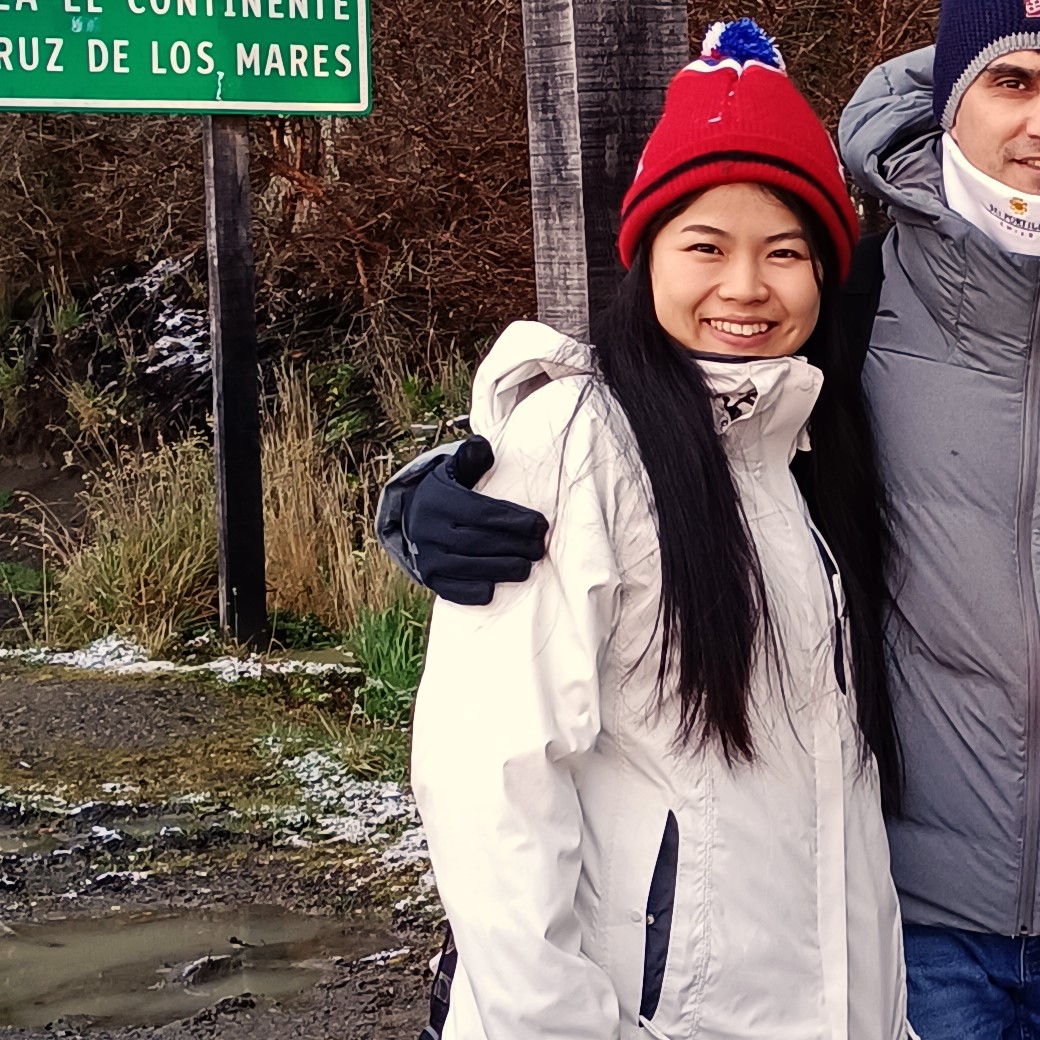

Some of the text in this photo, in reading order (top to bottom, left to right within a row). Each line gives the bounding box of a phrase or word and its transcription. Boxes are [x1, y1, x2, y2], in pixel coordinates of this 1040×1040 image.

[87, 38, 130, 73] DE
[151, 40, 215, 75] LOS
[236, 42, 352, 77] MARES
